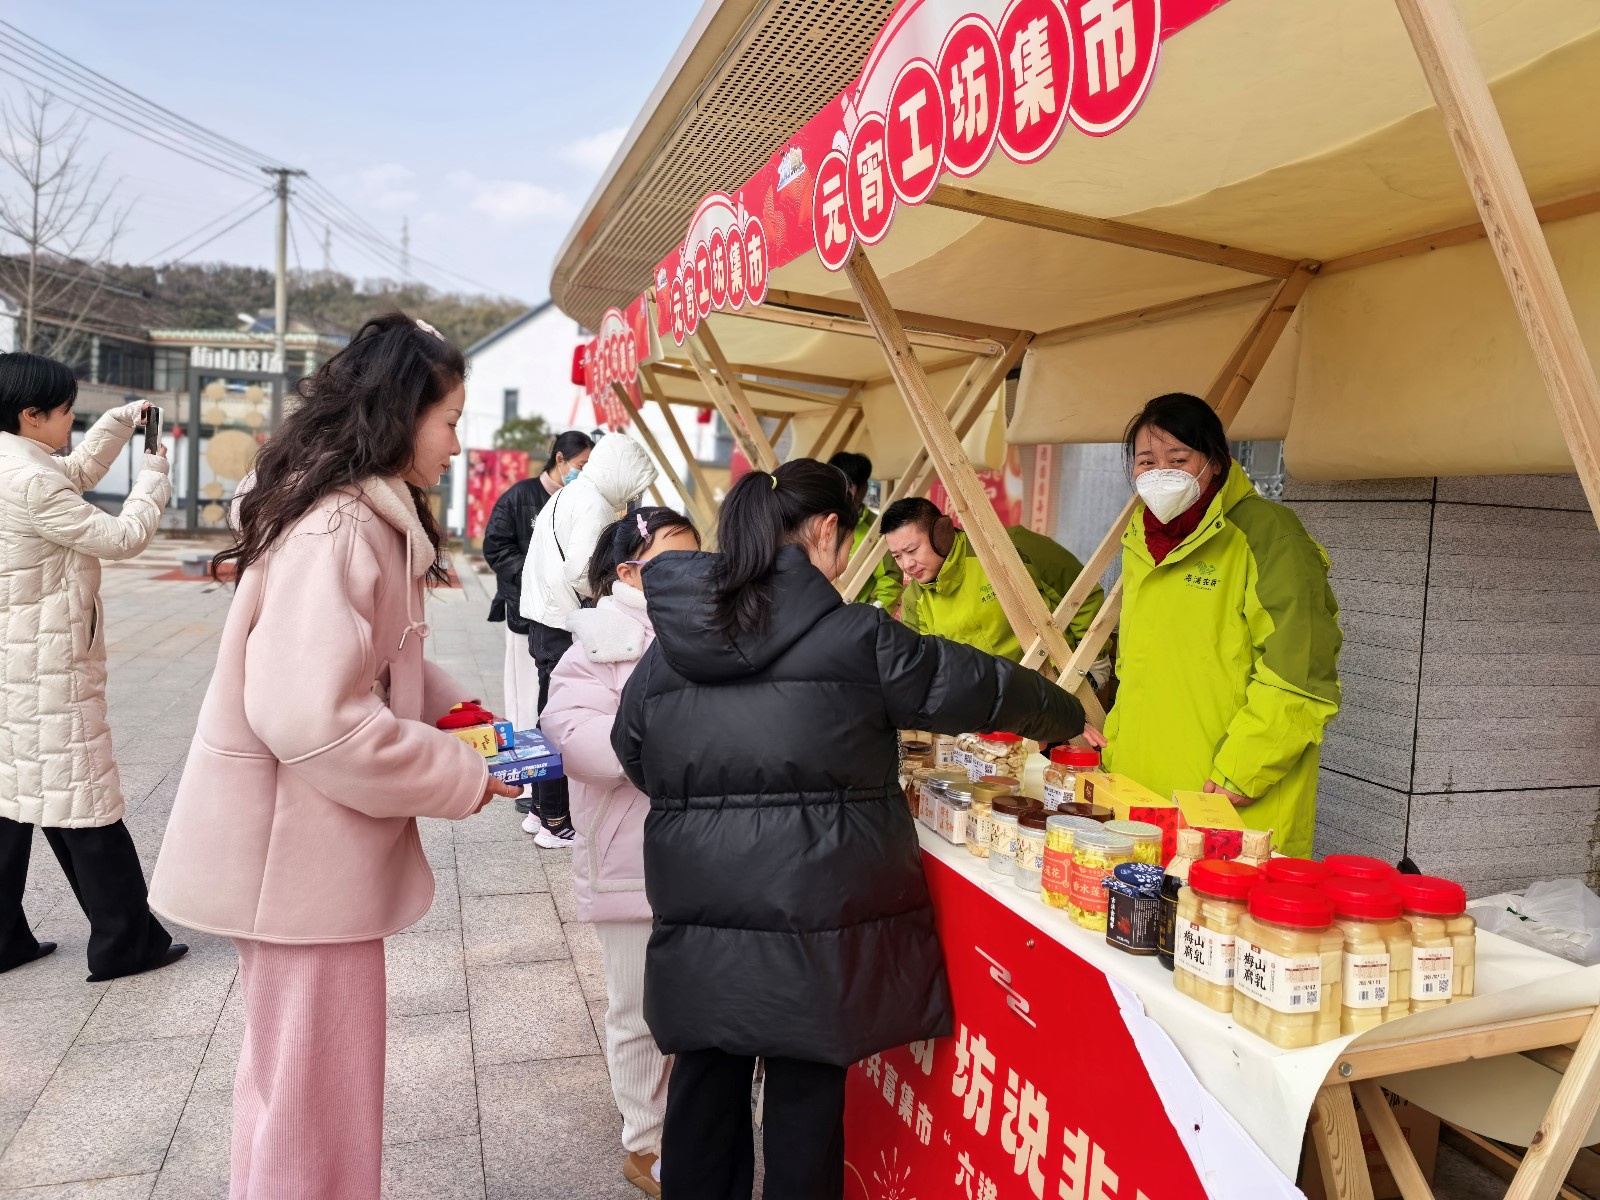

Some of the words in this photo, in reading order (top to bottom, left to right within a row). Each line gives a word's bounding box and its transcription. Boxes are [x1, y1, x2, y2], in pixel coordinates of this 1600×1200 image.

[822, 0, 1137, 244] 元宵工坊集市
[673, 234, 763, 334] 元宵工坊集市
[1243, 952, 1266, 973] 梅山
